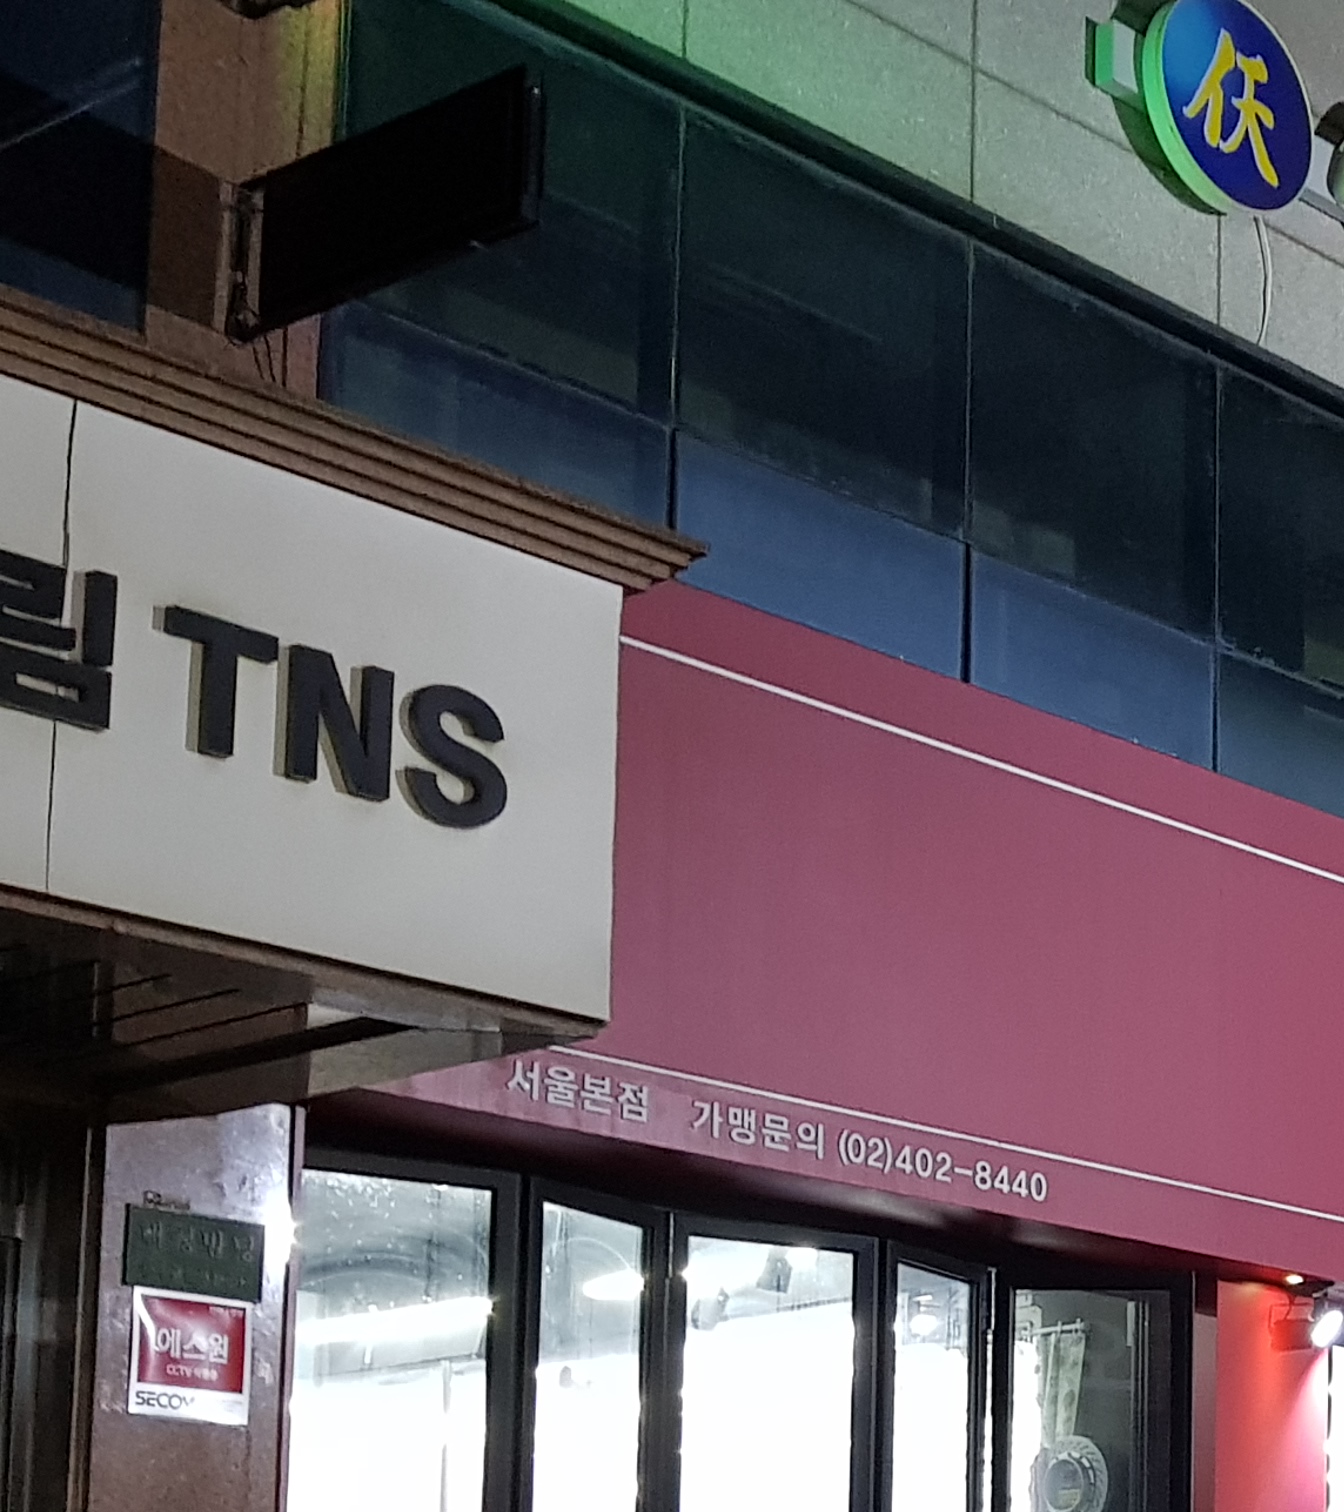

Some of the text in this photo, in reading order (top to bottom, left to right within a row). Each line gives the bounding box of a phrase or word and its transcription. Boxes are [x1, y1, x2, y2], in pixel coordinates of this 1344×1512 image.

[153, 605, 508, 830] TNS
[506, 1059, 1049, 1204] 서울본점 가맹문의 (02)402-8440
[156, 1326, 230, 1366] 에스원
